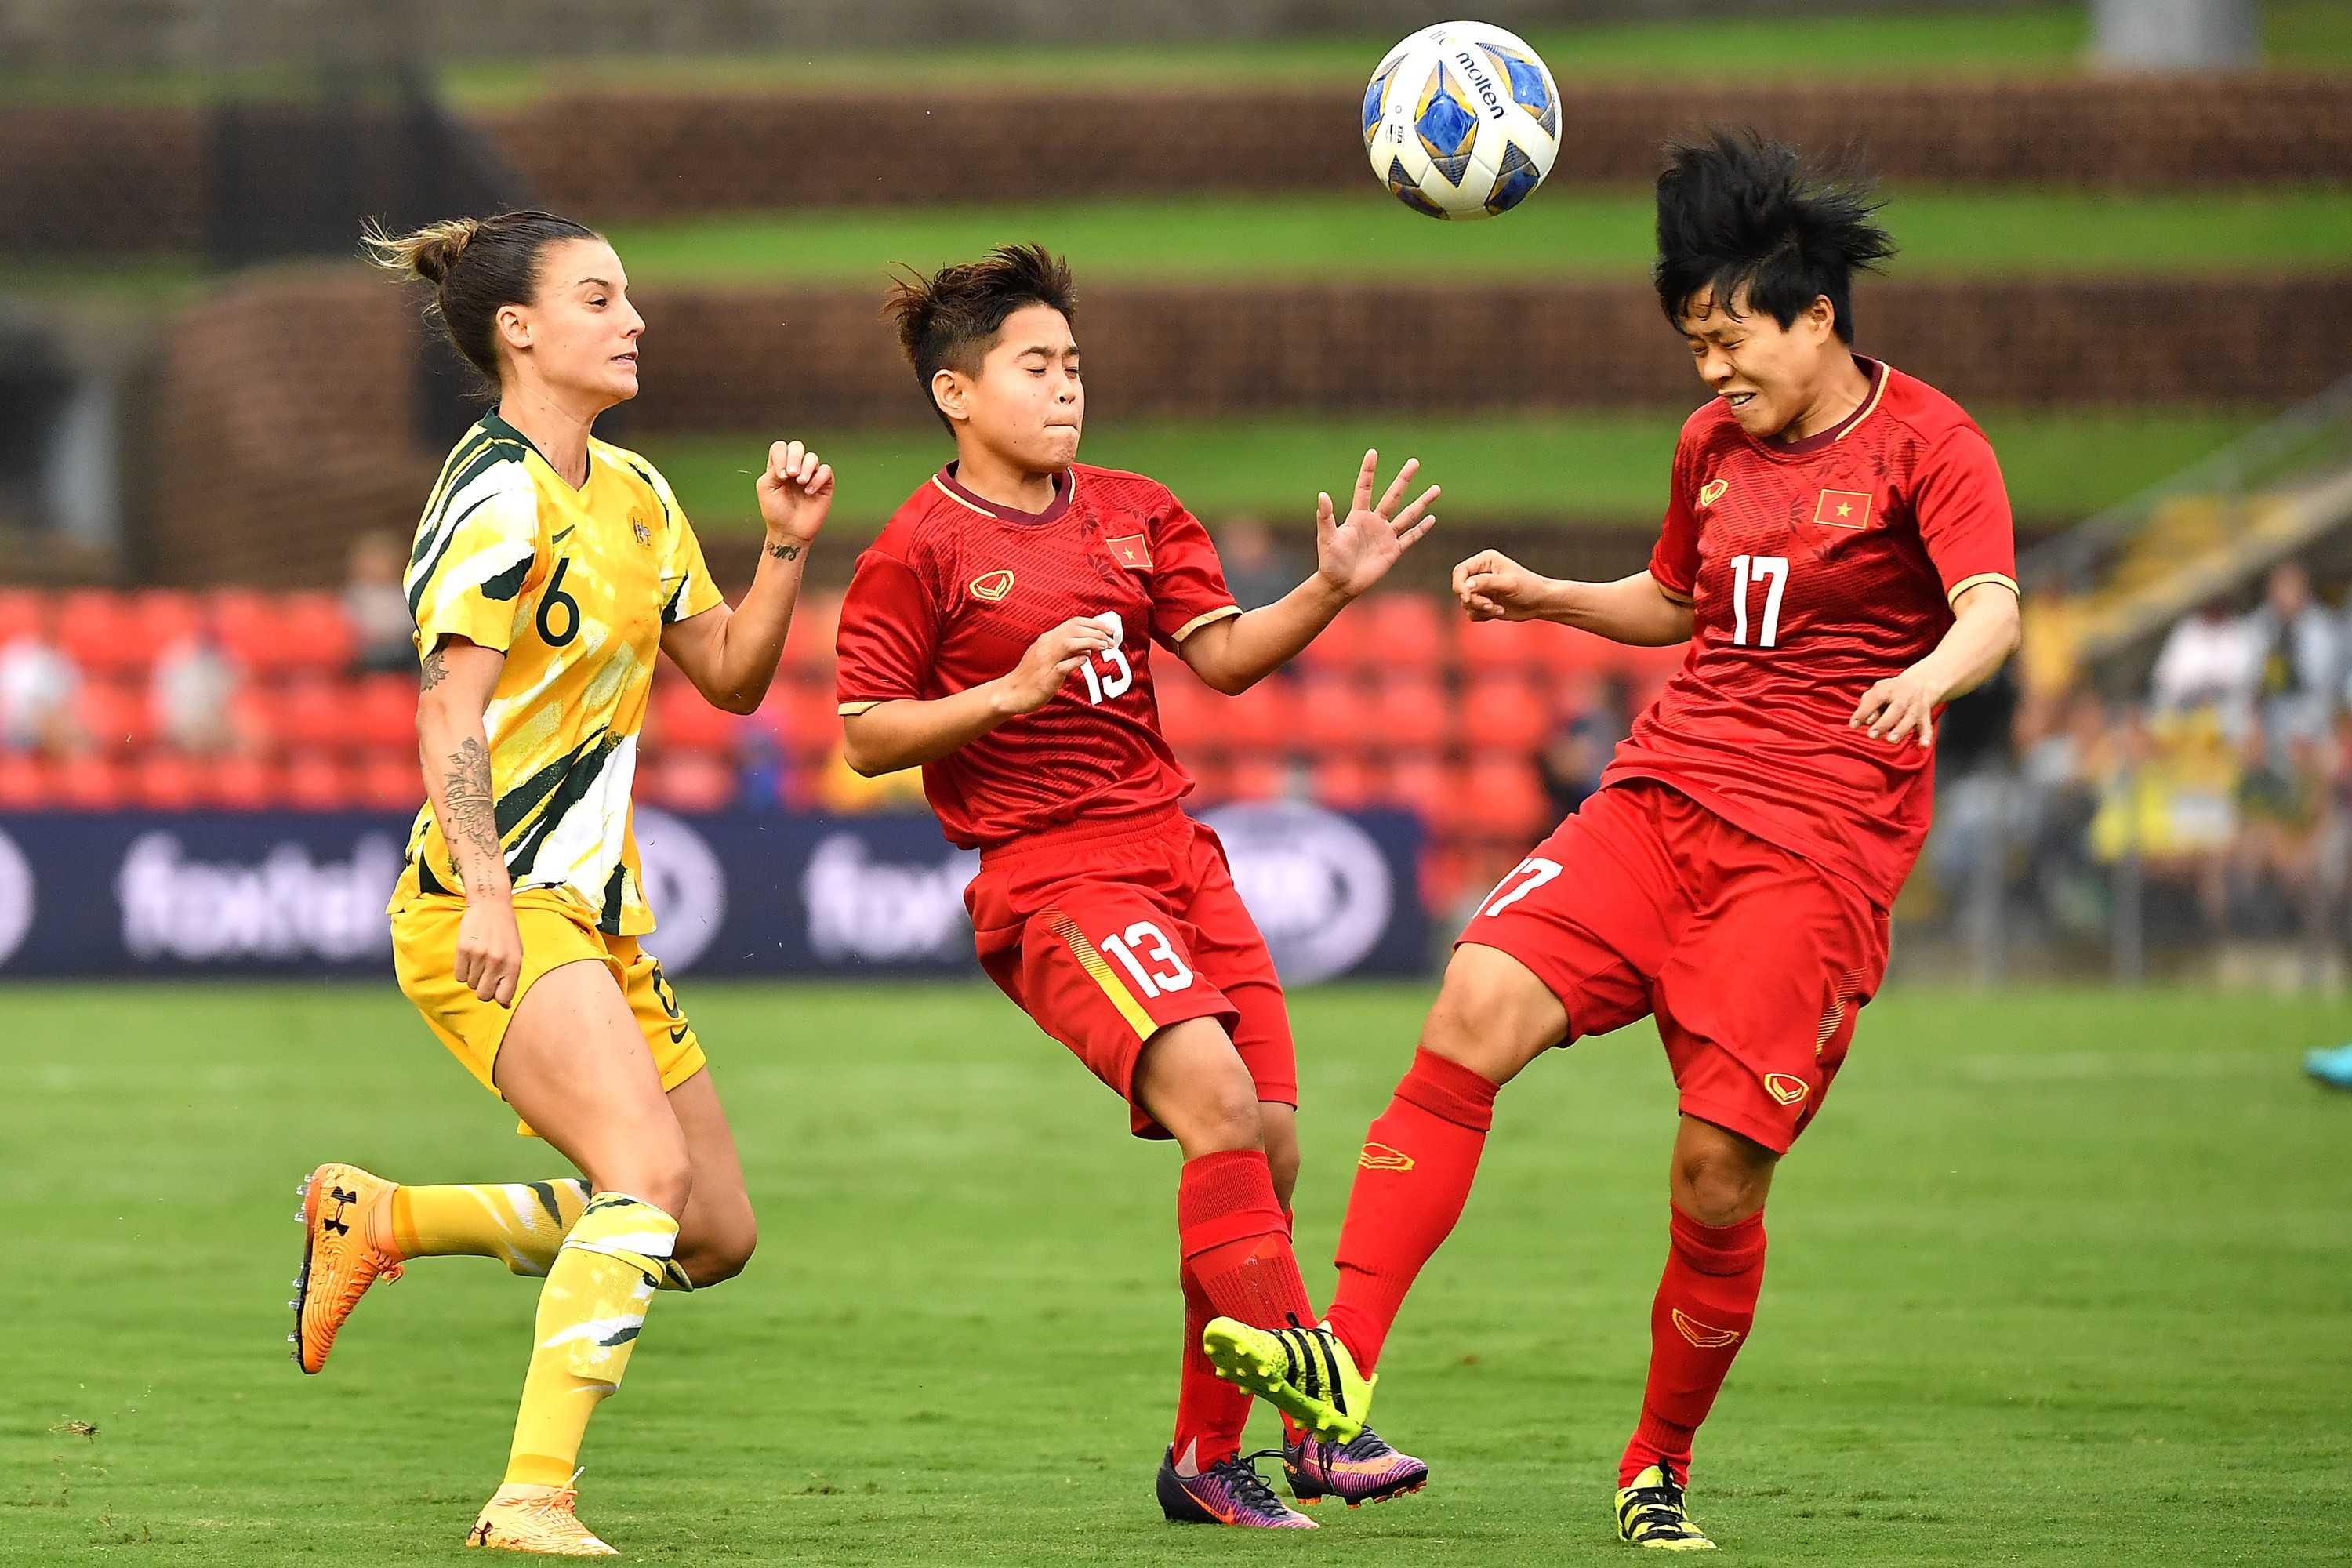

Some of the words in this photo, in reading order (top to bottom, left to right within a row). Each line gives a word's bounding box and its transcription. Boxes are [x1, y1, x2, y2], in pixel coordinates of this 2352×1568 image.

[1455, 52, 1505, 120] molten
[535, 557, 580, 648] 6
[1730, 554, 1790, 648] 17
[1080, 610, 1133, 706] 13
[1472, 857, 1564, 918] 17
[1100, 920, 1194, 999] 13
